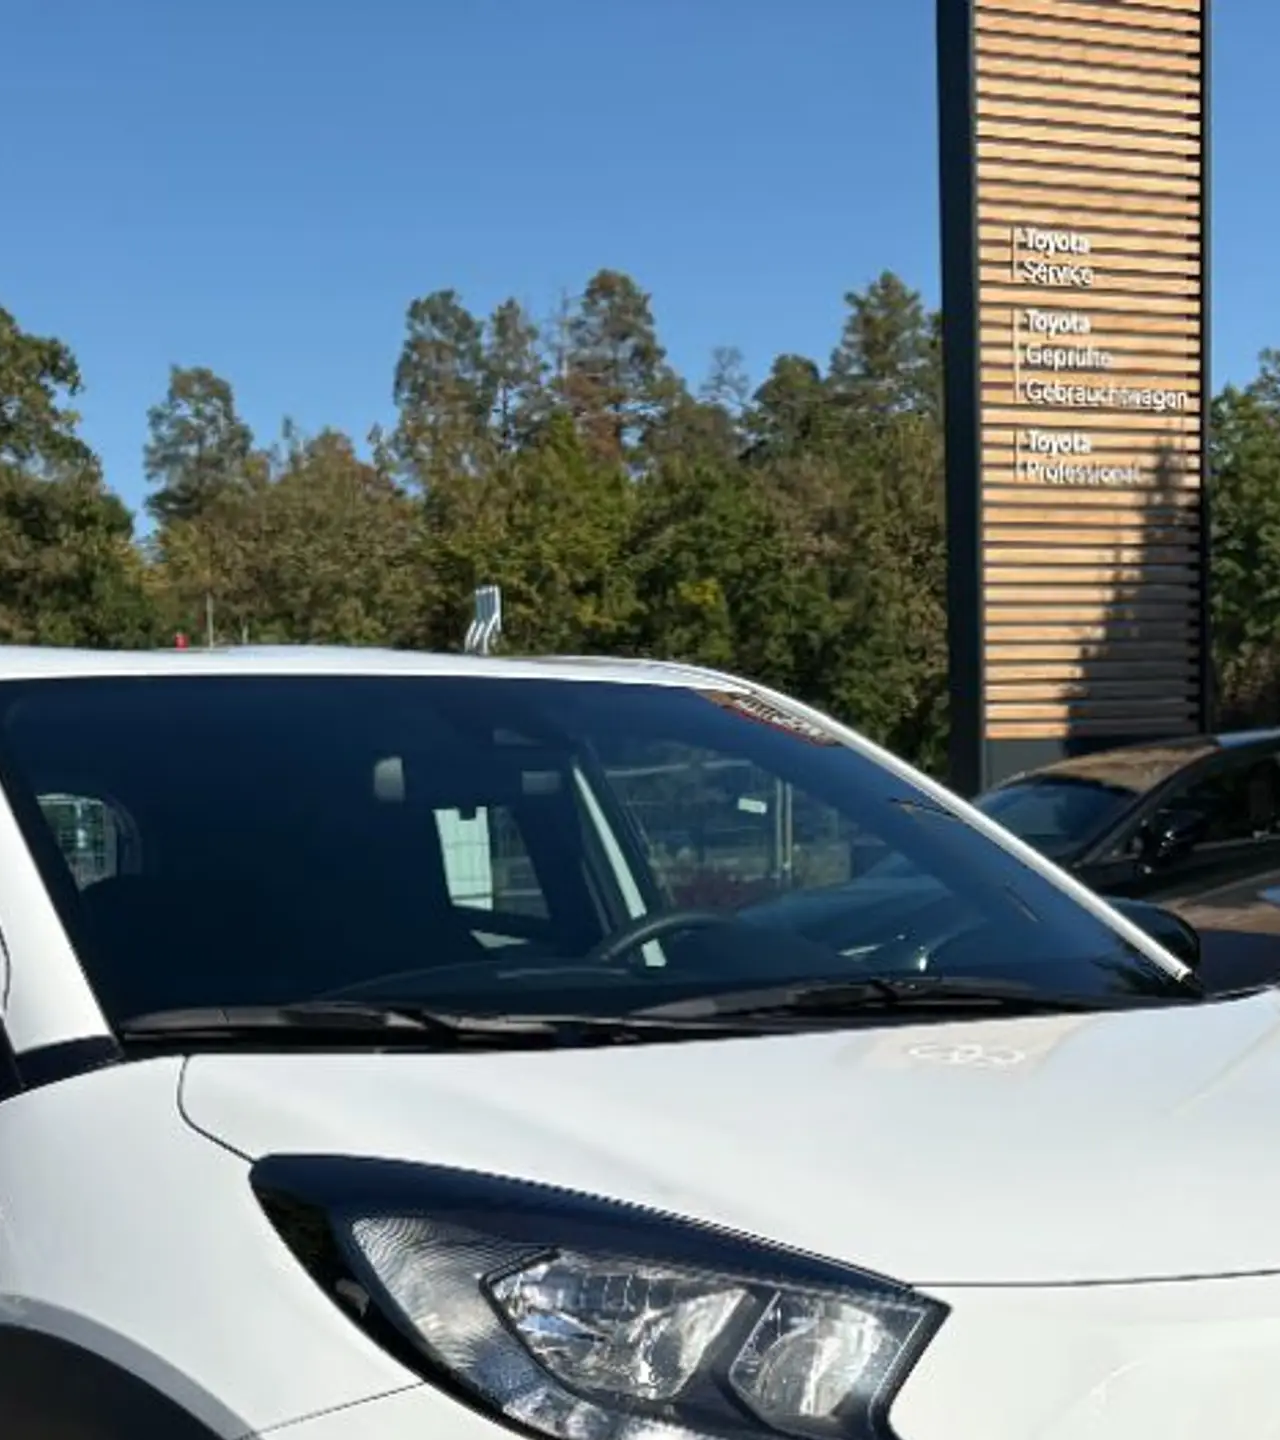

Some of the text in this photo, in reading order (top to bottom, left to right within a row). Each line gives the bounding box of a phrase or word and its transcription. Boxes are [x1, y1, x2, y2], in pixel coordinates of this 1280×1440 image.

[1024, 228, 1091, 256] Toyota
[1023, 260, 1094, 286] Service
[1026, 309, 1091, 337] Toyota
[1027, 378, 1188, 412] Gebrauchtwagen
[1027, 430, 1091, 457] Toyota
[1026, 460, 1140, 485] Professional
